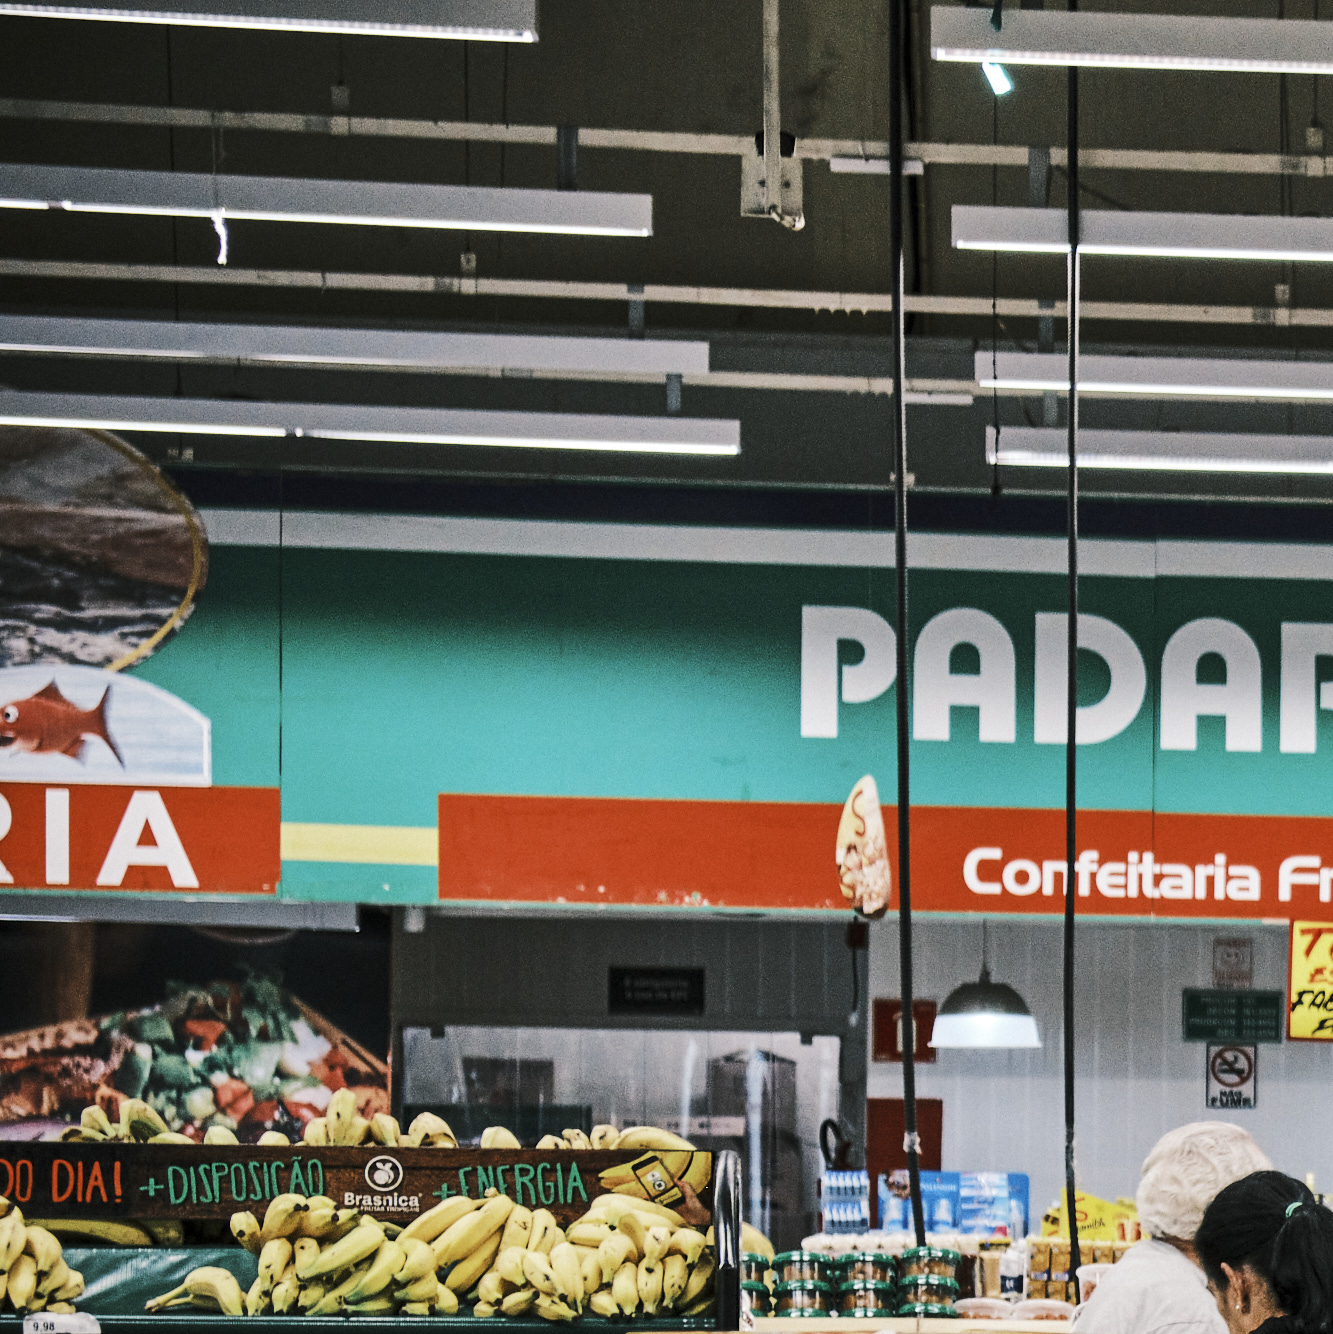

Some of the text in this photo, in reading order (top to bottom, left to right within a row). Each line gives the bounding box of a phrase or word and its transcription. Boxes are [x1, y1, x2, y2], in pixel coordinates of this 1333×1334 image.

[0, 787, 200, 888] IA
[963, 845, 1261, 902] Confeitaria
[52, 1159, 122, 1203] DIA!
[344, 1191, 418, 1207] Brasnica
